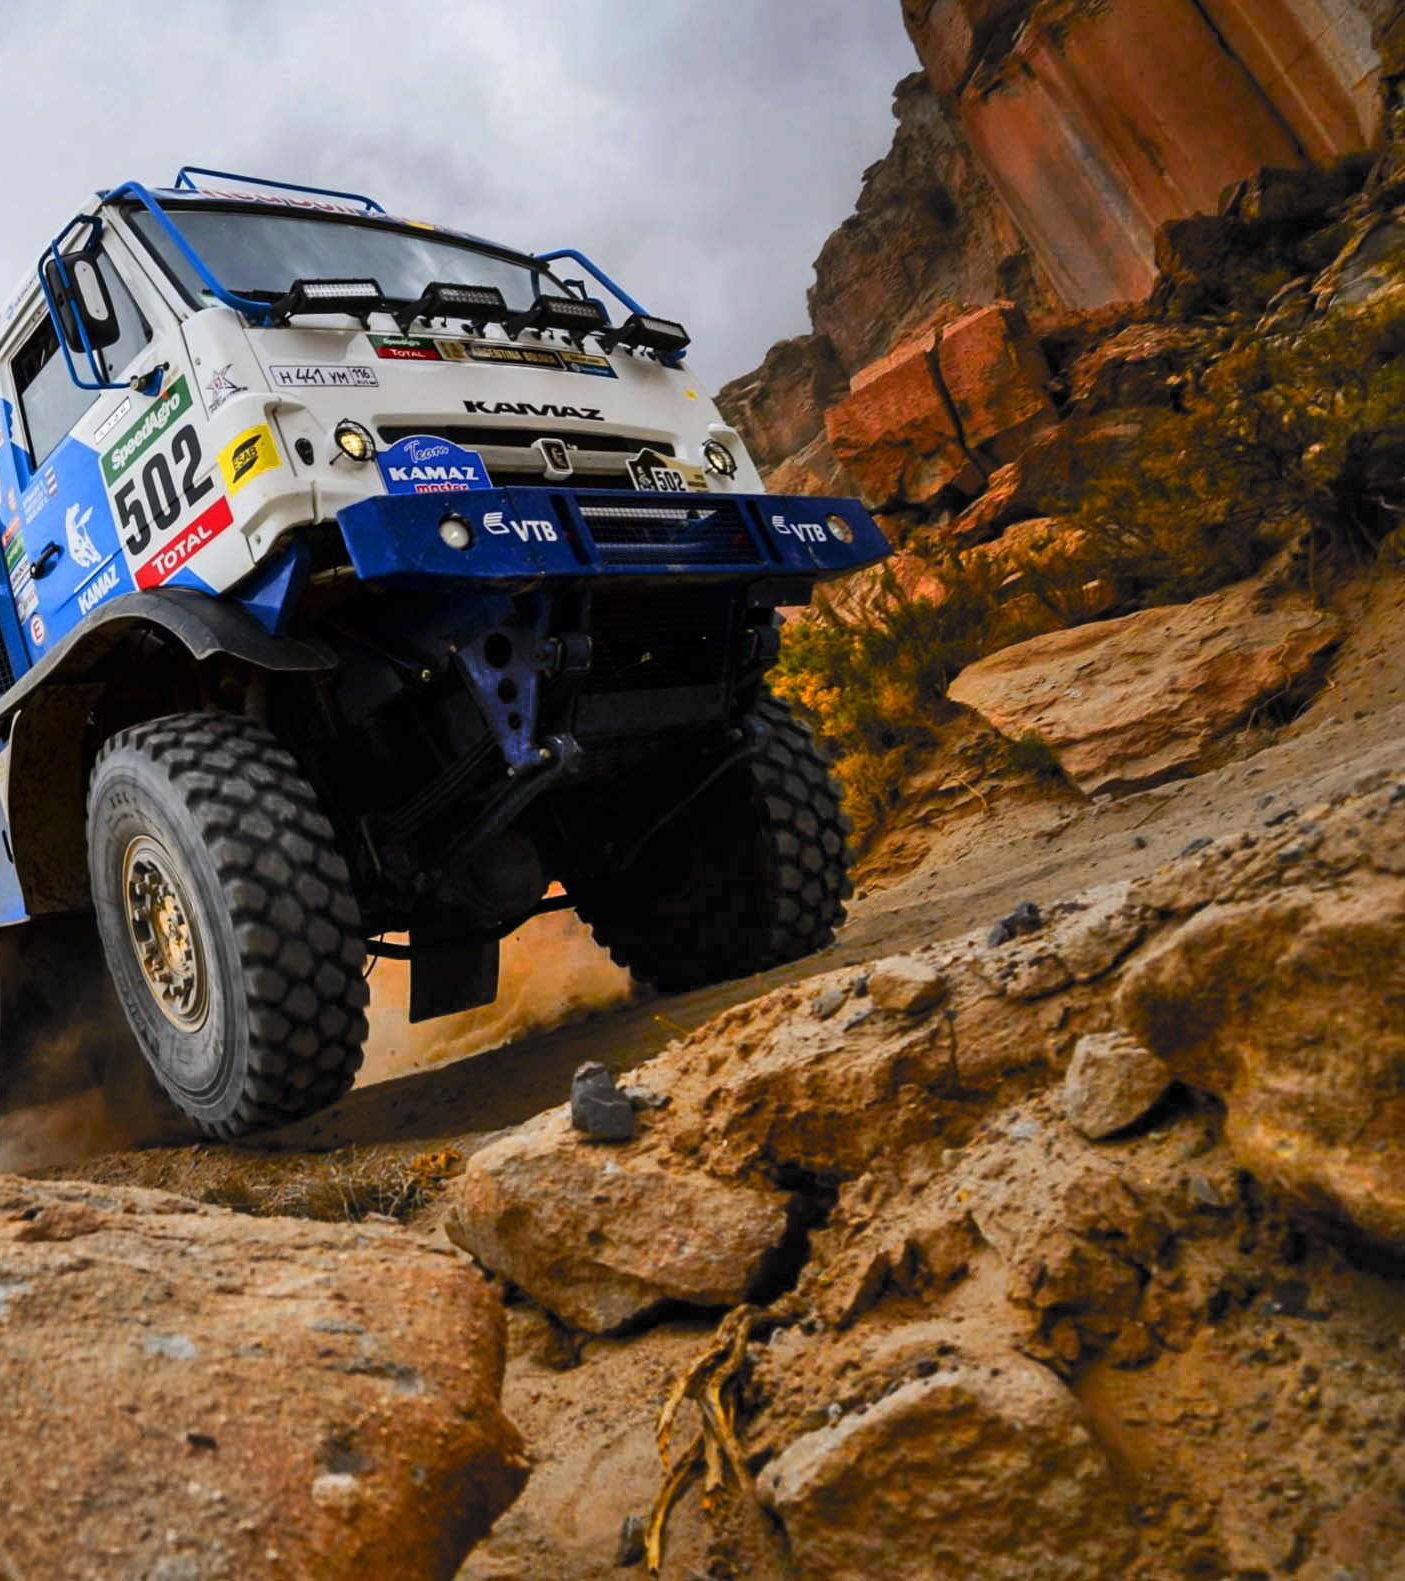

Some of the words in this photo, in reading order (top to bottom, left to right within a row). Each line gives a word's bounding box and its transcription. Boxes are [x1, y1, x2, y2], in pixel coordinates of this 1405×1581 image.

[389, 349, 426, 358] TOTAL
[296, 368, 325, 383] 441
[352, 368, 370, 379] 116
[463, 400, 604, 421] KAMAZ
[111, 393, 180, 470] SpeedAgro
[404, 440, 449, 463] Team
[388, 466, 479, 480] KAMAZ
[654, 471, 686, 491] 502
[114, 424, 214, 555] 502
[510, 520, 557, 542] VTB
[790, 523, 828, 542] VTB
[152, 525, 212, 575] TOTAL
[78, 564, 120, 615] KAMAZ
